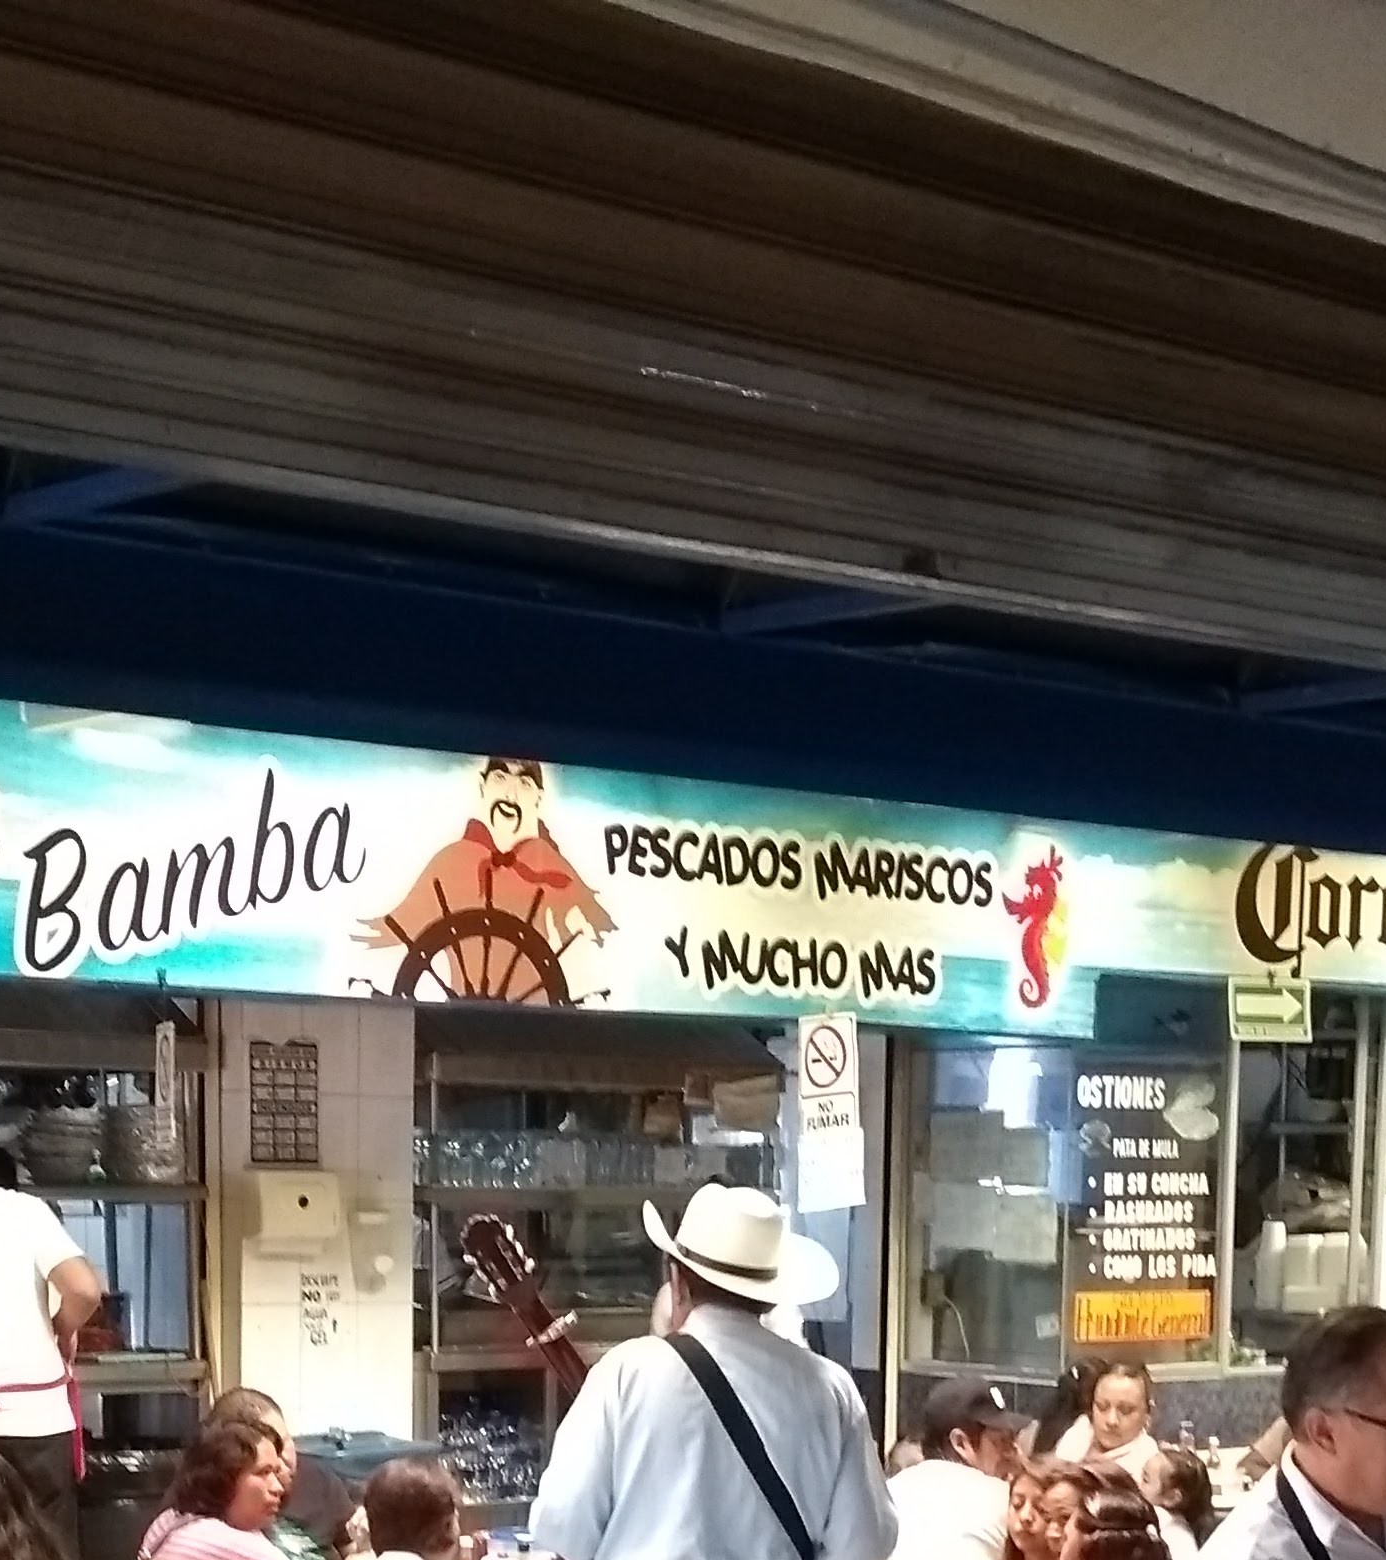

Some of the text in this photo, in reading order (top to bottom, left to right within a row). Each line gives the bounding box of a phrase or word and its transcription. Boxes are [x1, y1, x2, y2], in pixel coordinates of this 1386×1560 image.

[23, 768, 365, 972] Bamba
[605, 825, 994, 907] PESCADOS MARISCOS
[664, 926, 936, 999] Y MUCHO MAS
[1077, 1075, 1166, 1109] OSTIONES
[818, 1100, 834, 1112] NO
[807, 1113, 850, 1131] FUMAR
[1113, 1138, 1179, 1159] PATA DE MULA
[1104, 1172, 1209, 1195] EN SU CONCHA
[1103, 1227, 1196, 1251] GRATINADOS
[1104, 1253, 1216, 1279] COMO LOS PIDA
